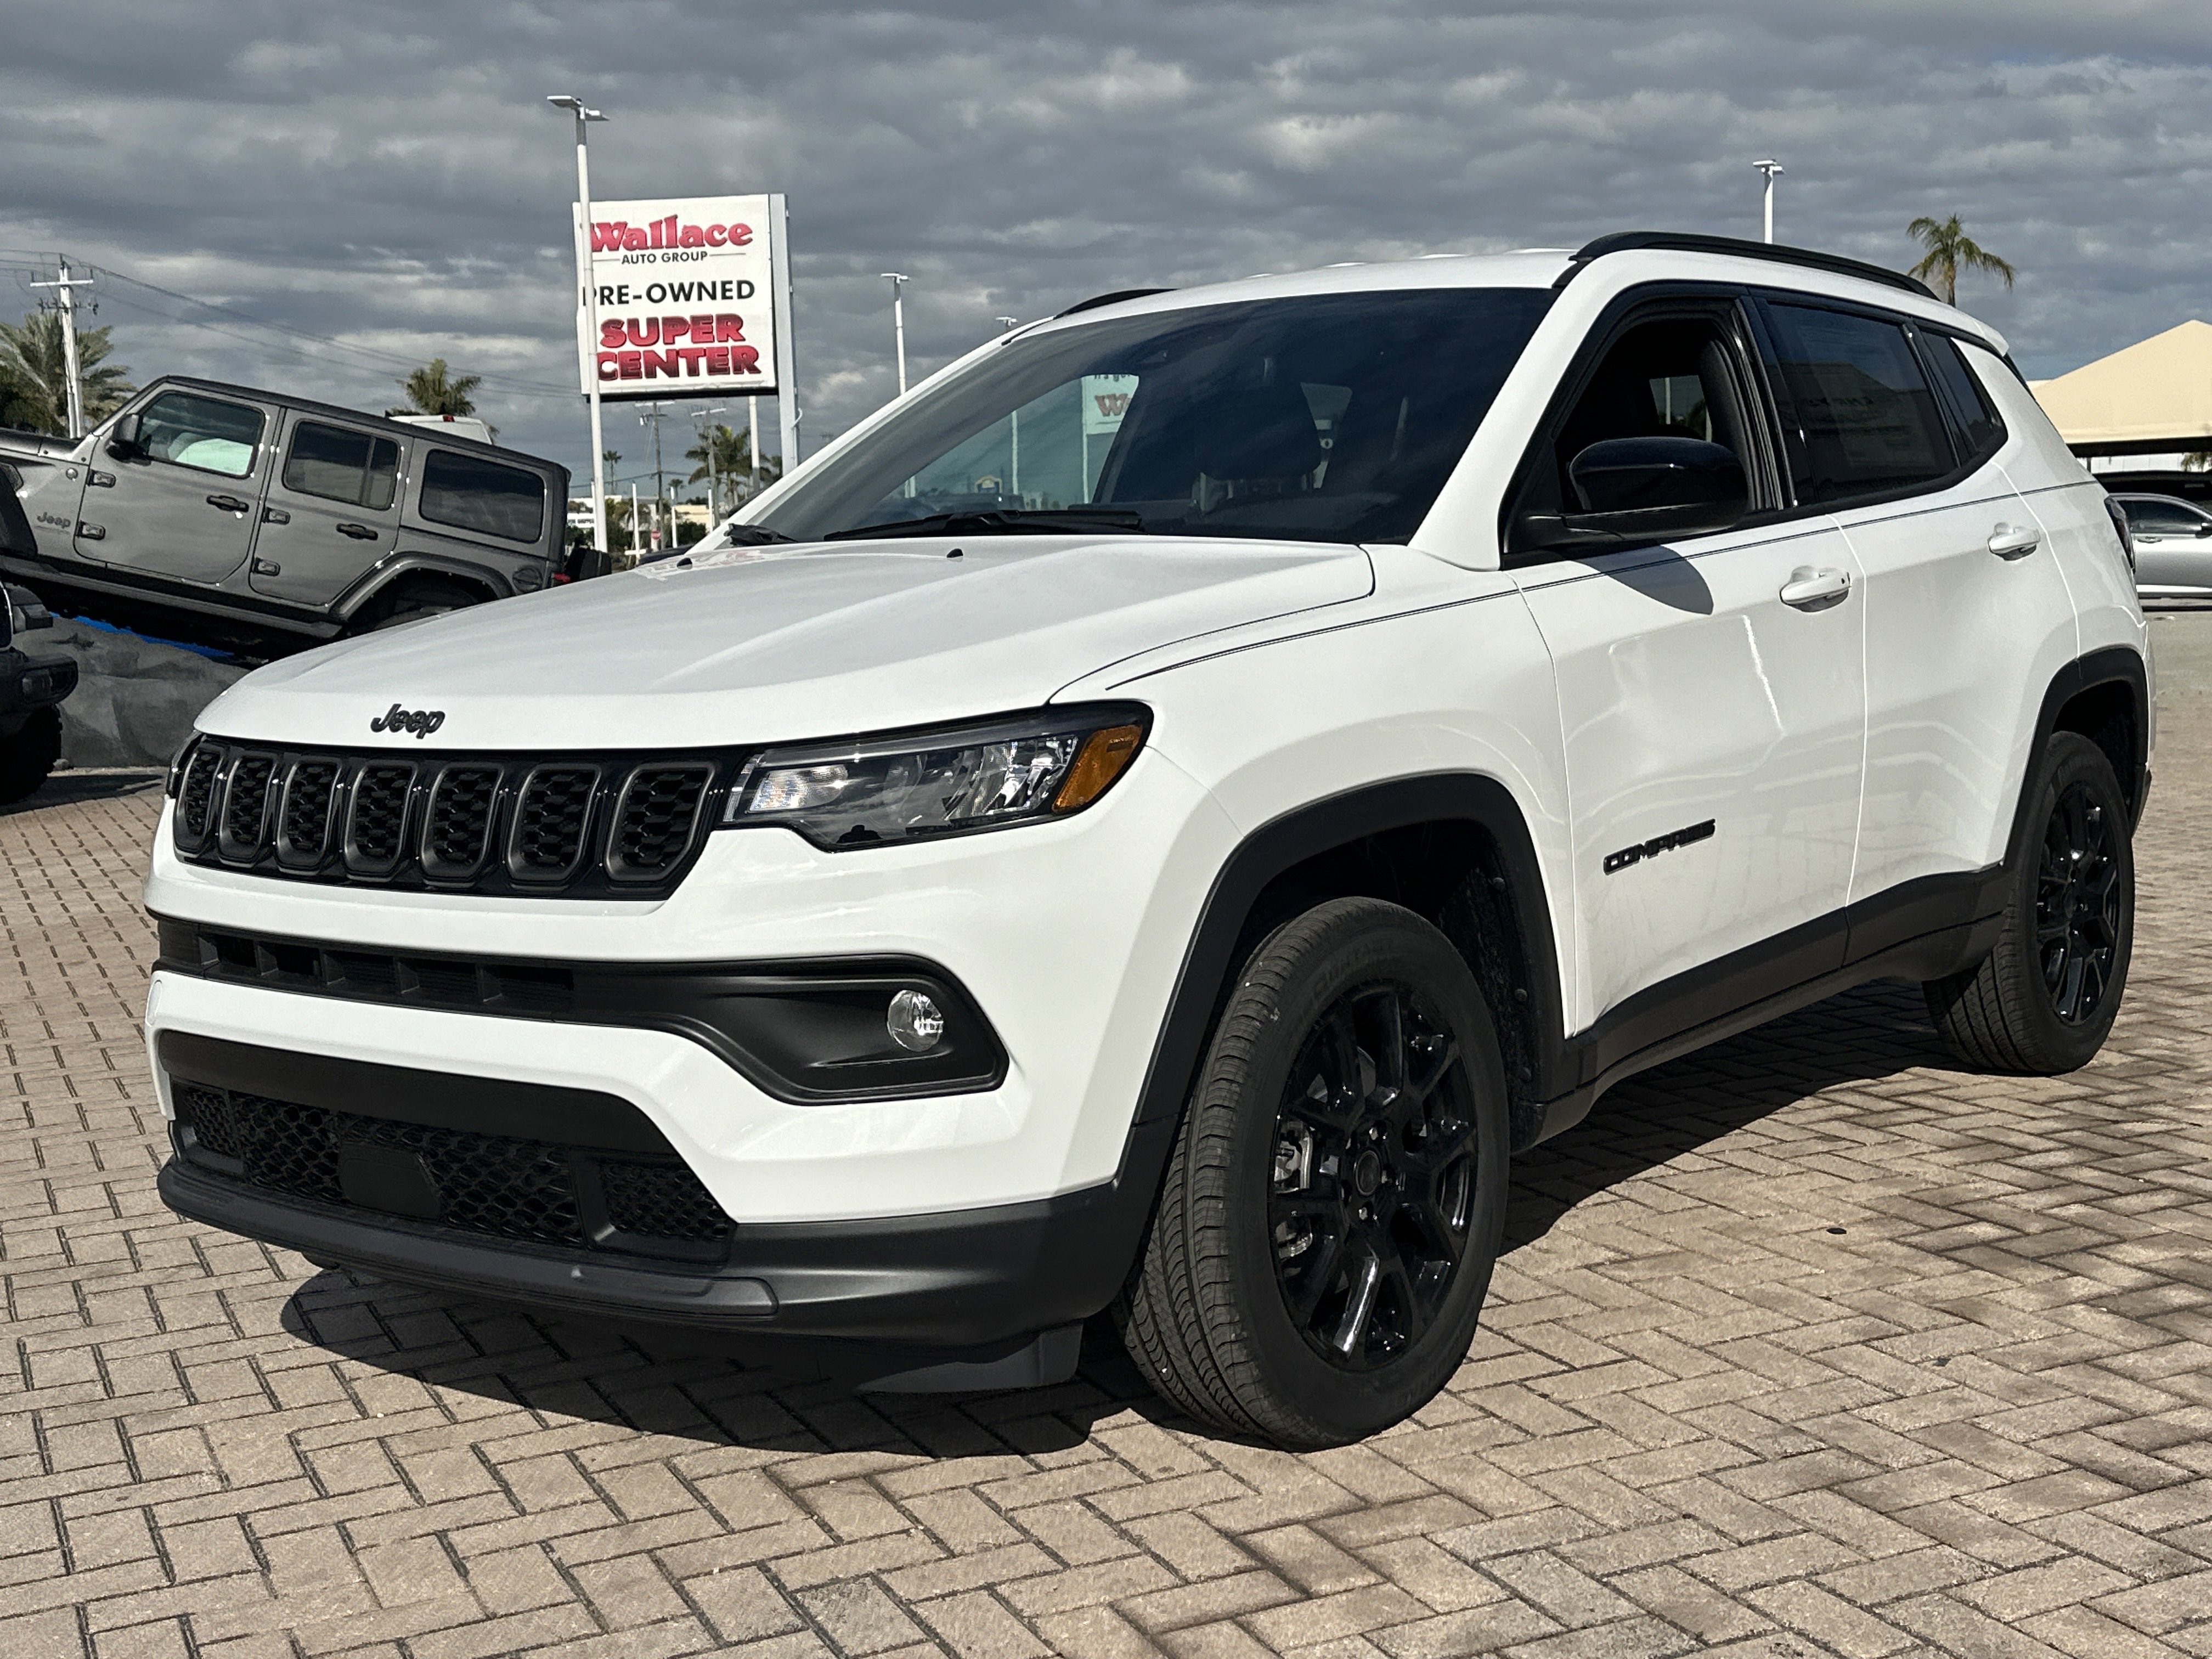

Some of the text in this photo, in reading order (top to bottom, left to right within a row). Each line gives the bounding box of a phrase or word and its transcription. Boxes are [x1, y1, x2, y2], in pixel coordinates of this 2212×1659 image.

[580, 215, 753, 252] Wallace
[622, 251, 708, 264] AUTO GROUP
[600, 313, 746, 348] SUPER
[597, 345, 761, 381] CENTER
[37, 511, 71, 529] Jeep
[370, 703, 445, 740] Jeep
[1603, 819, 1716, 876] COMPASS
